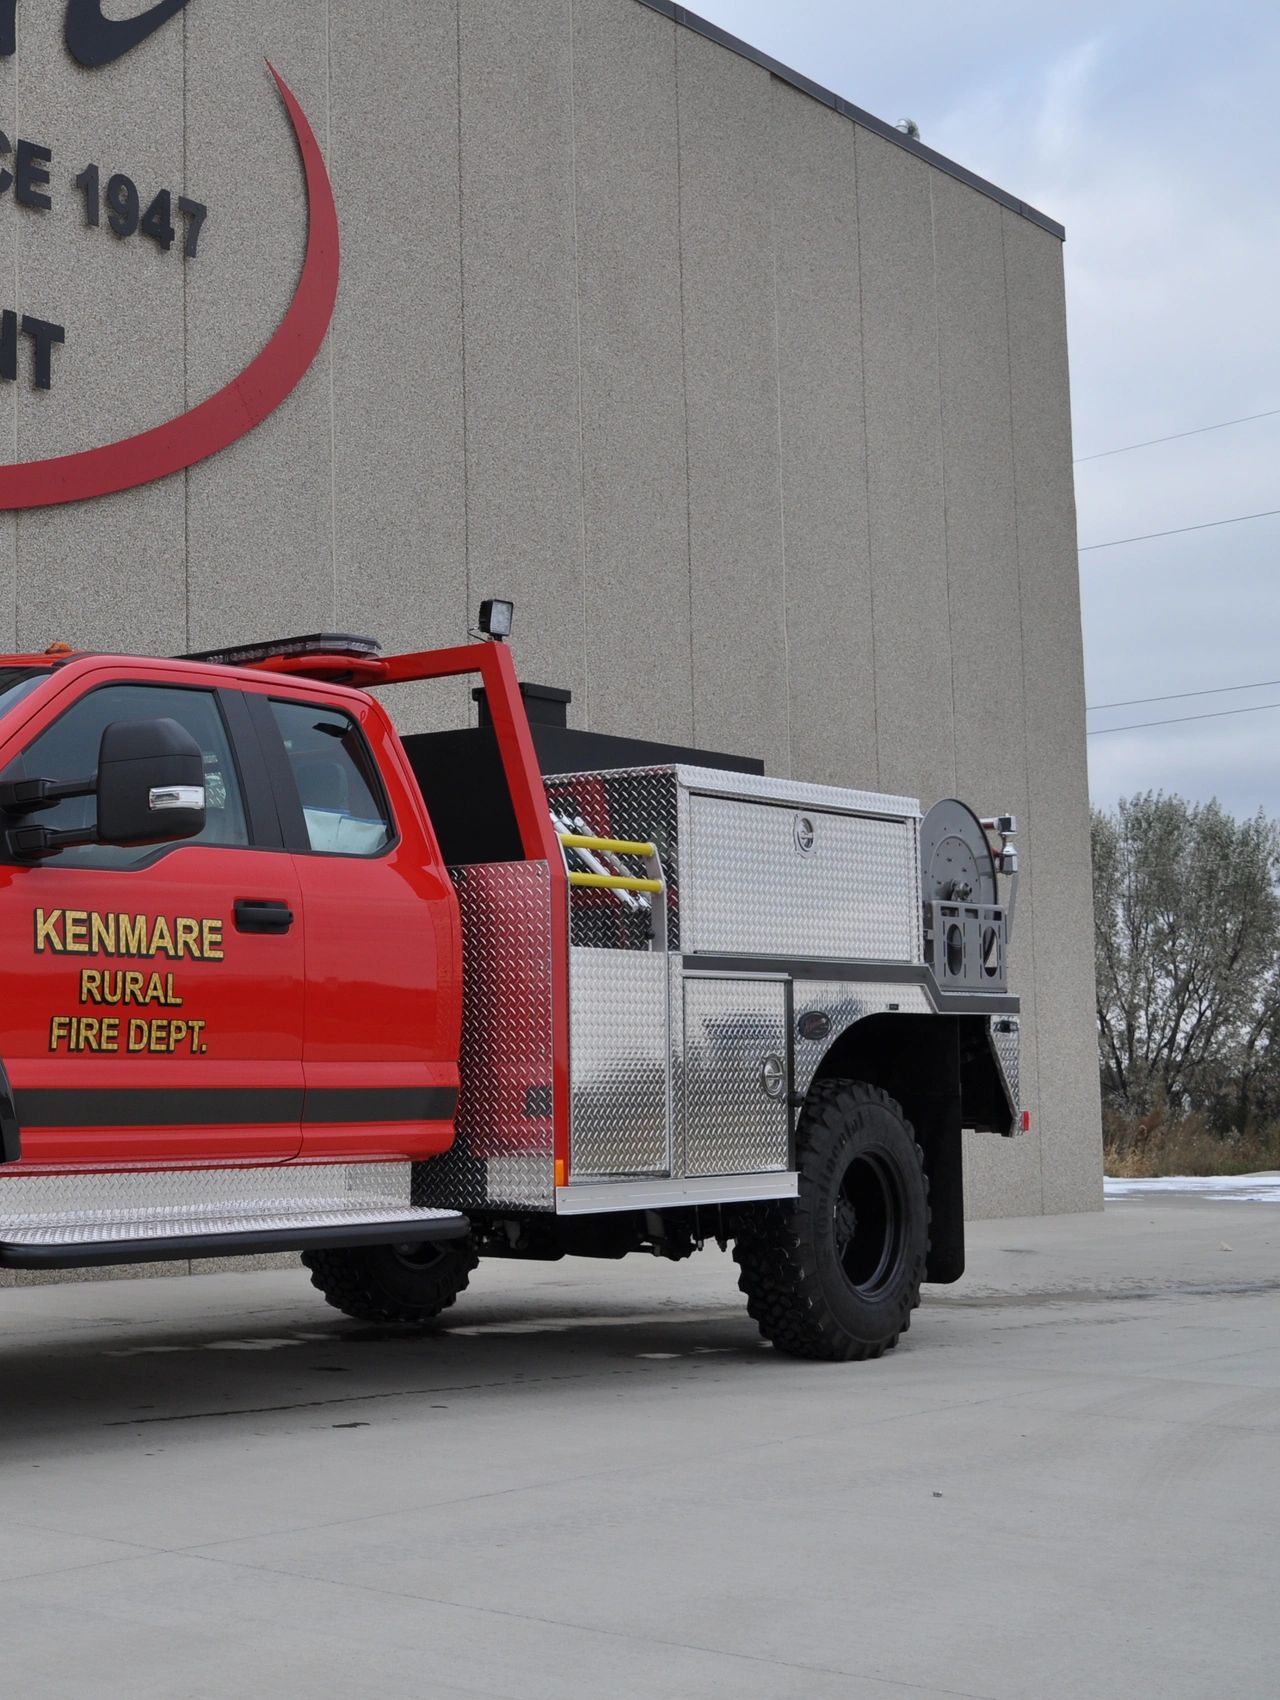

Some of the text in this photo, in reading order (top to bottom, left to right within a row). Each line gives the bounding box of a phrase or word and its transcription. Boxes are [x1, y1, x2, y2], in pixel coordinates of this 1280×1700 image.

[76, 162, 208, 258] 1947
[34, 907, 224, 959] KENMARE
[79, 969, 183, 1007] RURAL
[49, 1016, 208, 1054] FIRE DEPT.
